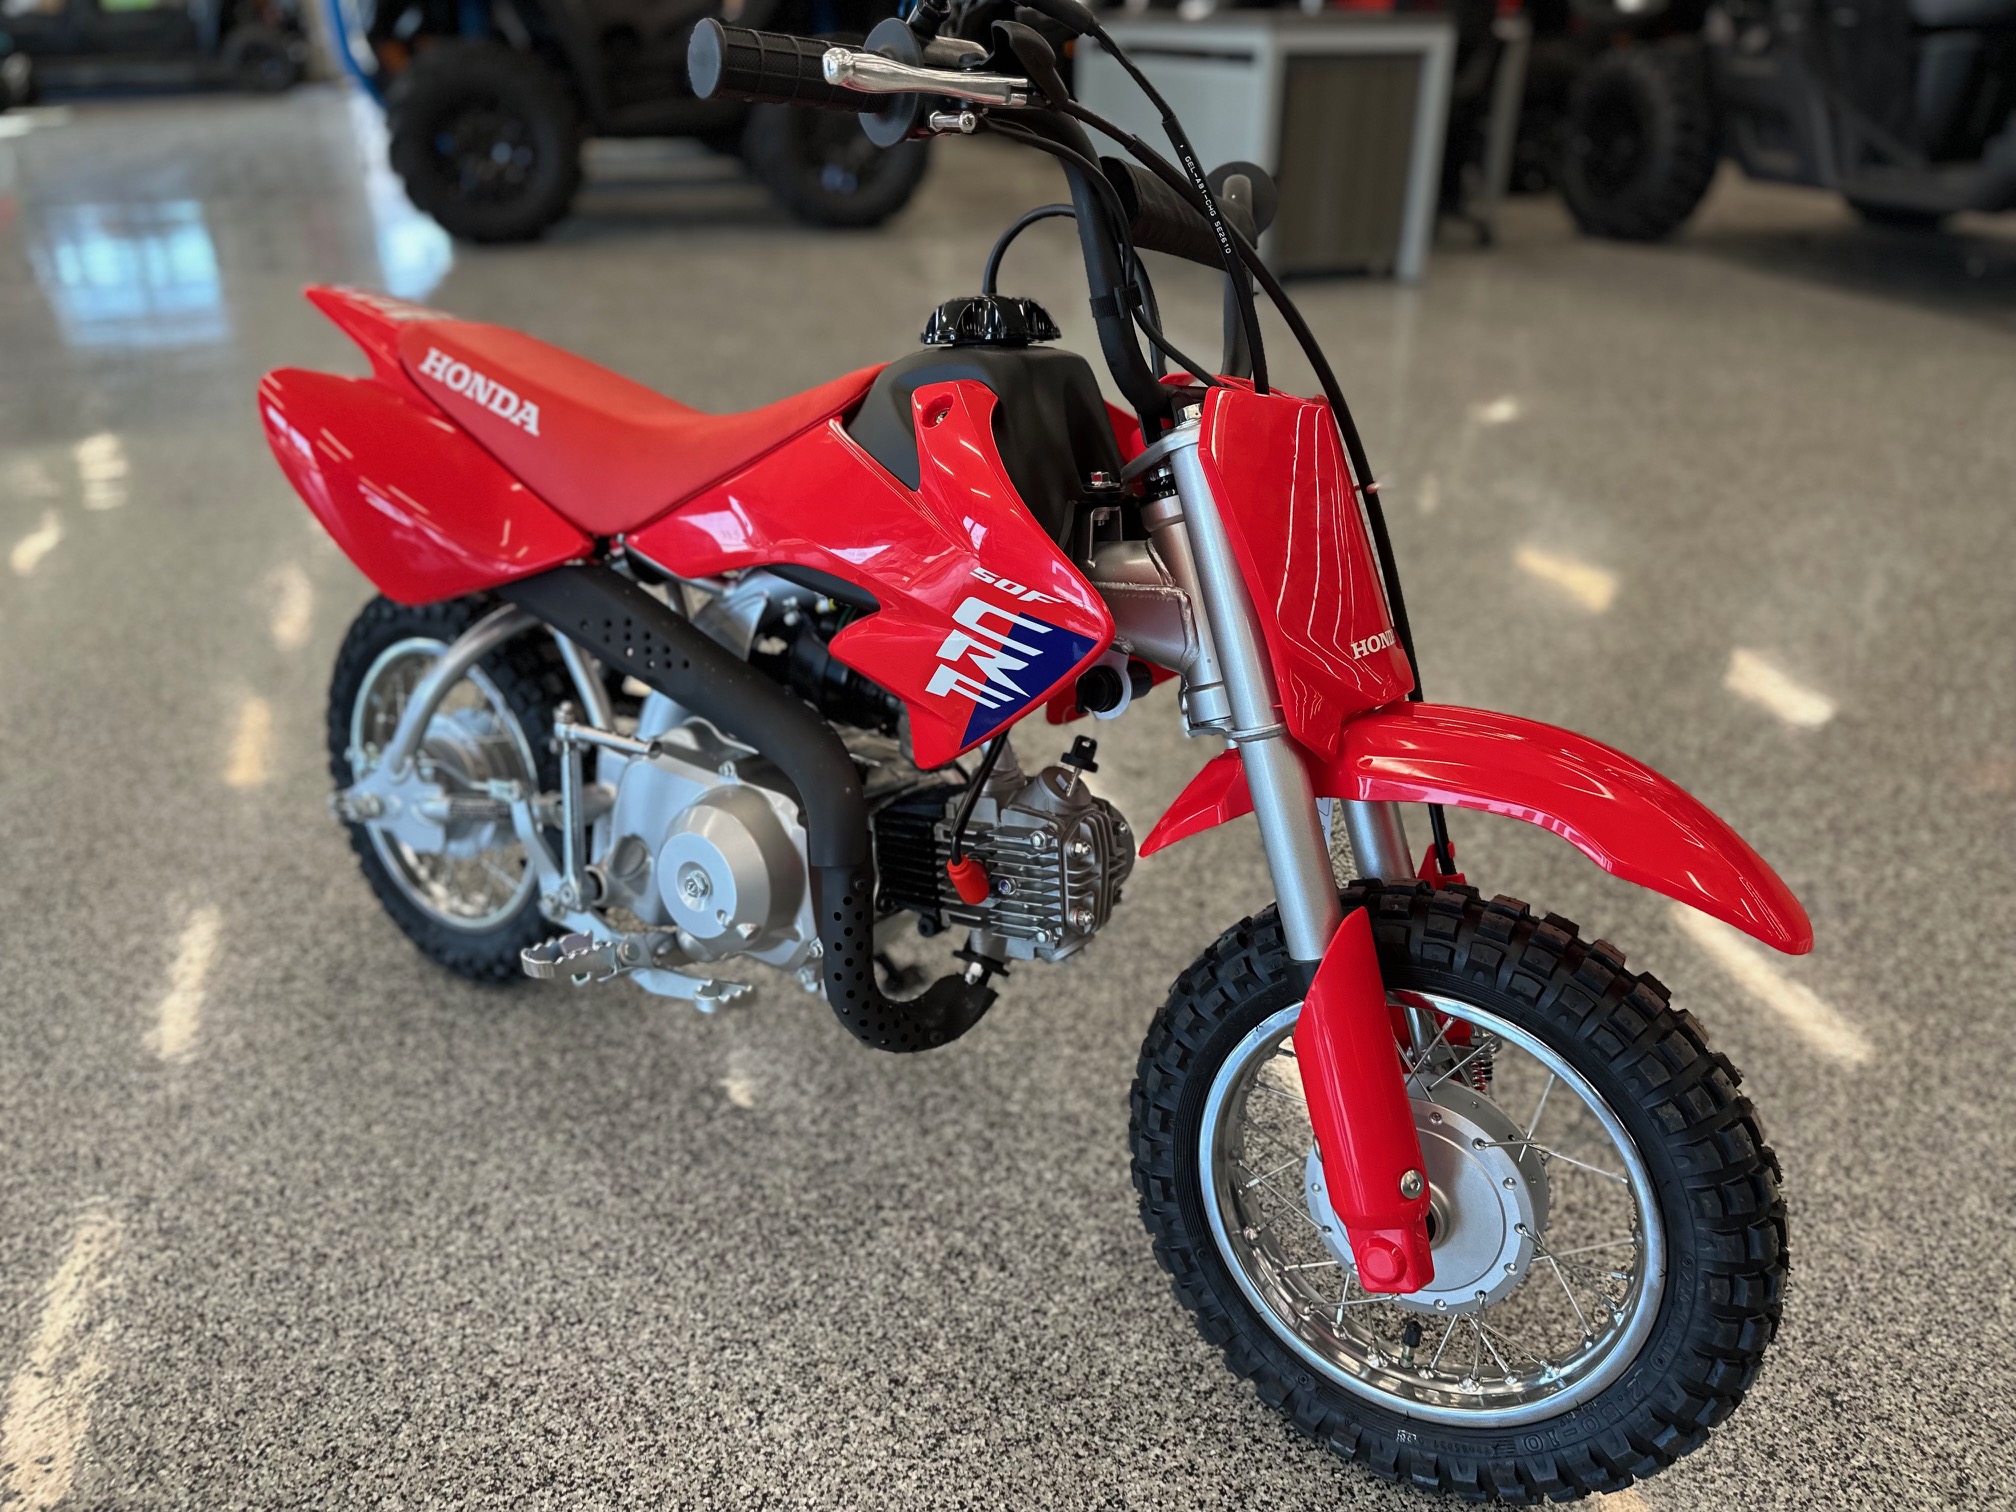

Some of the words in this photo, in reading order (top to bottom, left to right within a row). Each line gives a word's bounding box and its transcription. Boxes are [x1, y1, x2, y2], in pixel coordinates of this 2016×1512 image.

[418, 346, 540, 437] HONDA
[970, 566, 1066, 604] 50F
[925, 596, 1053, 710] CRF
